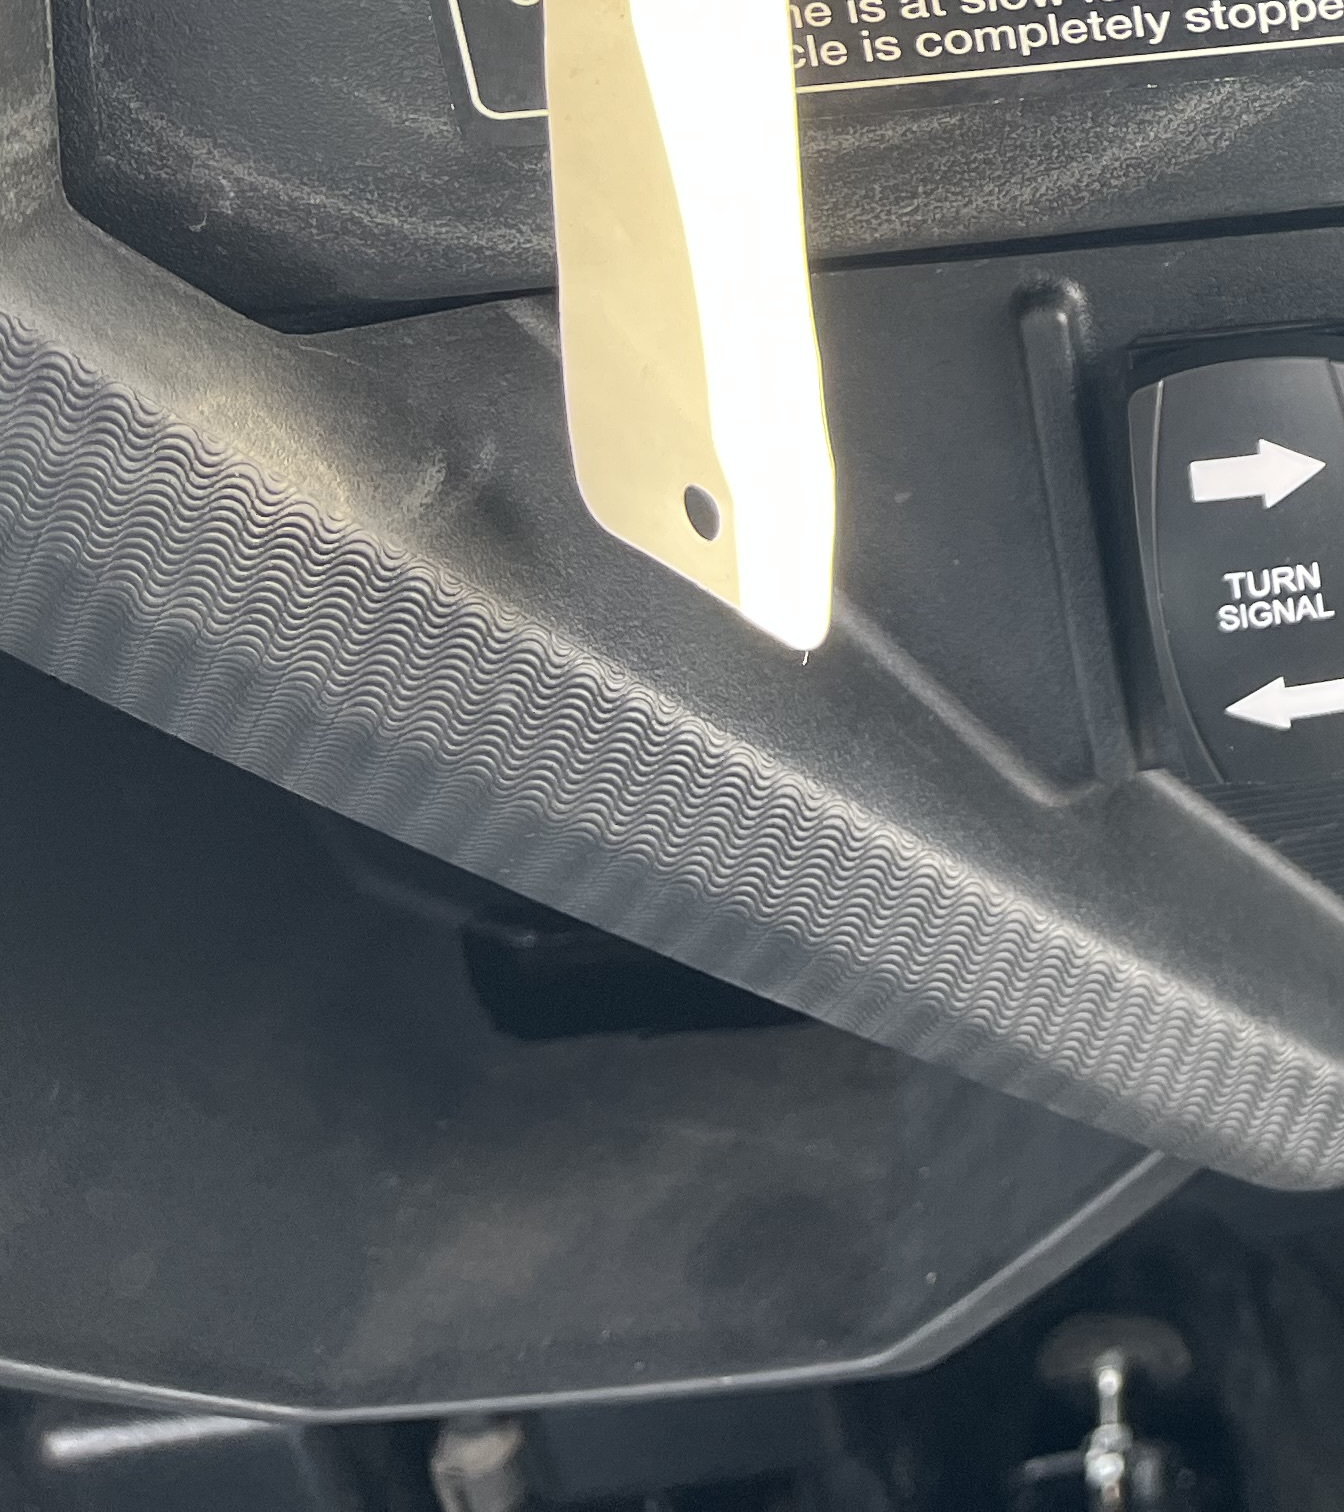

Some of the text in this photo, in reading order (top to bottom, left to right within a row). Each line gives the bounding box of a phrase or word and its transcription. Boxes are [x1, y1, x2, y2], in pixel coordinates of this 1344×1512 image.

[860, 30, 903, 64] is
[914, 4, 1171, 57] completely
[1223, 561, 1322, 600] TURN
[1216, 591, 1336, 634] SIGNAL
